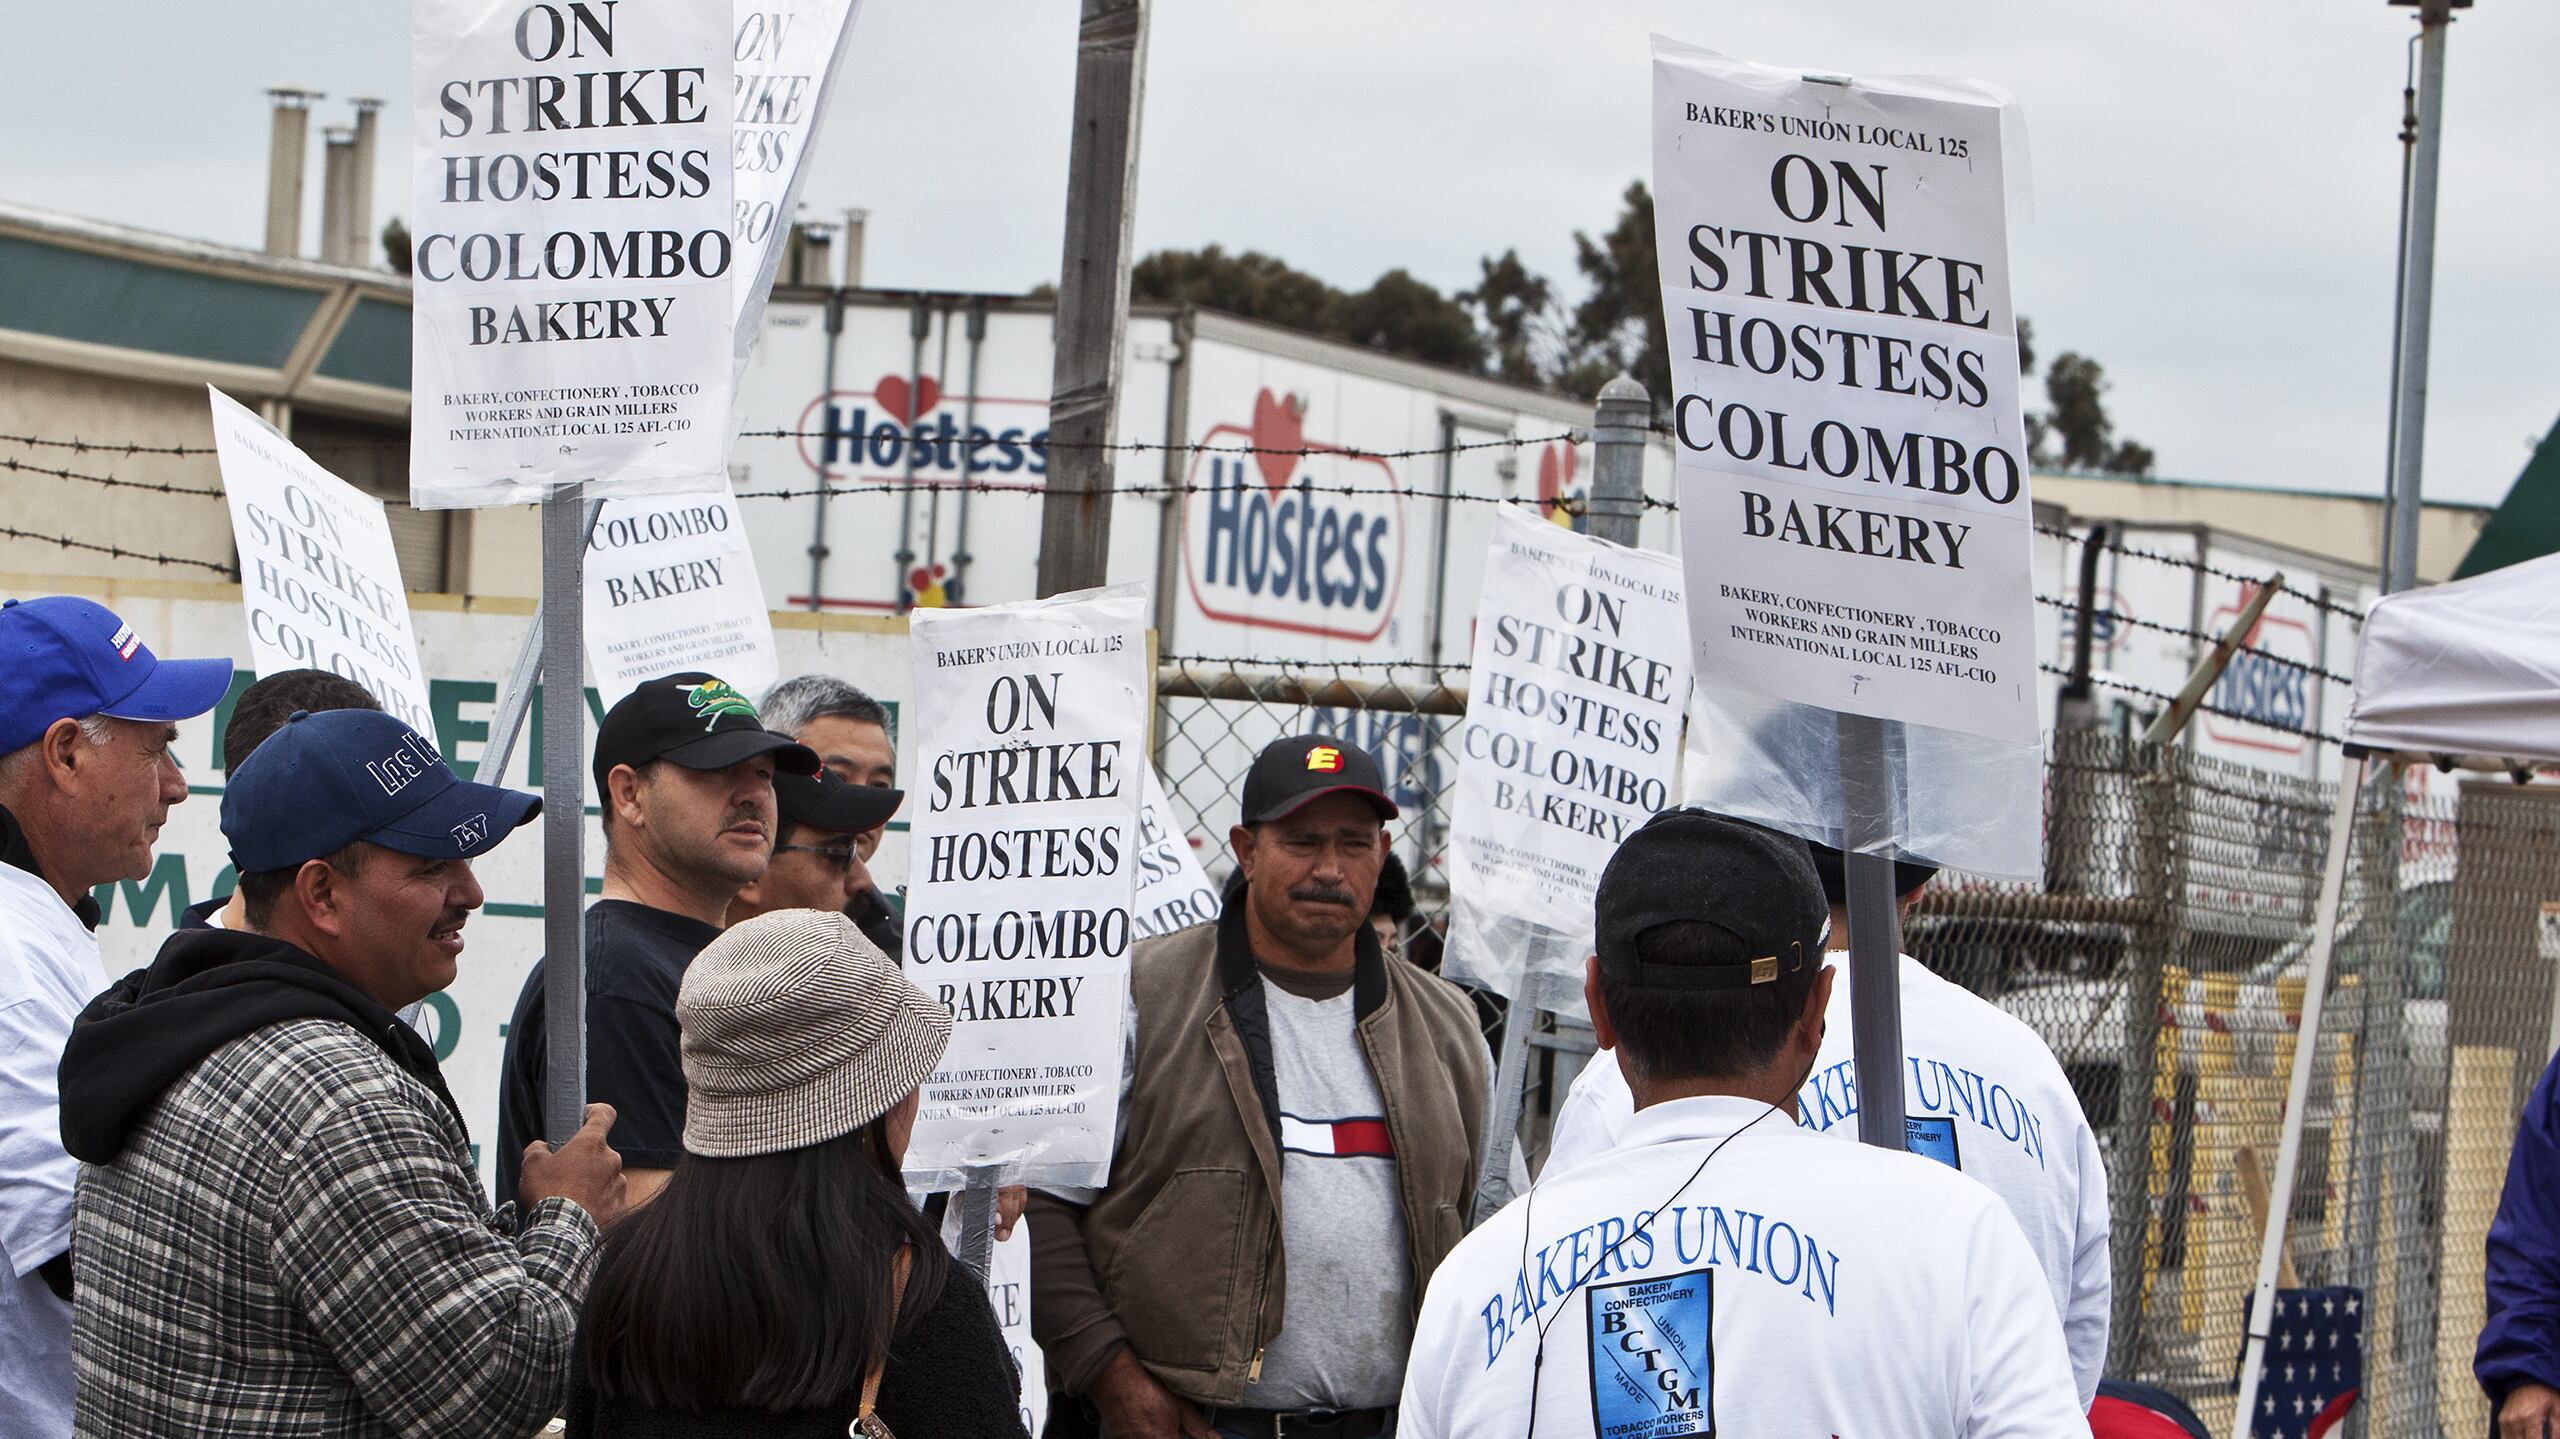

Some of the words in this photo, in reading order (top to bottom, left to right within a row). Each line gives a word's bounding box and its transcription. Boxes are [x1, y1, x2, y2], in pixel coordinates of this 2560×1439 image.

[515, 1, 618, 62] ON
[734, 12, 795, 63] ON
[440, 67, 708, 139] STRIKE
[1686, 102, 1775, 134] BAKER'S
[1780, 115, 1850, 143] UNION
[1858, 124, 1933, 153] LOCAL
[1938, 136, 1968, 159] 125
[440, 150, 711, 203] HOSTESS
[1771, 154, 1888, 233] ON
[417, 229, 732, 283] COLOMBO
[1688, 224, 1990, 330] STRIKE
[469, 297, 676, 346] BAKERY
[1686, 307, 1989, 408] HOSTESS
[465, 408, 533, 423] WORKERS
[536, 406, 563, 419] AND
[566, 404, 611, 418] GRAIN
[614, 402, 678, 416] MILLERS
[504, 386, 620, 403] CONFECTIONERY
[630, 383, 699, 398] TOBACCO
[450, 424, 560, 441] INTERNATIONAL
[562, 422, 610, 437] LOCAL
[613, 421, 635, 434] 125
[637, 419, 691, 433] AFL-CIO
[825, 407, 1050, 474] Hostess
[1675, 394, 2020, 505] COLOMBO
[284, 484, 344, 551] ON
[590, 504, 728, 551] COLOMBO
[1205, 456, 1388, 612] Hostess
[1740, 490, 1971, 569] BAKERY
[246, 502, 401, 631] STRIKE
[605, 557, 726, 608] BAKERY
[1614, 573, 1657, 598] LOCAL
[1661, 589, 1681, 604] 125
[256, 556, 412, 681] HOSTESS
[1556, 583, 1626, 638] ON
[1745, 608, 1818, 634] WORKERS
[1821, 624, 1851, 640] AND
[1855, 631, 1906, 648] GRAIN
[1910, 638, 1978, 660] MILLERS
[1786, 597, 1915, 629] CONFECTIONERY
[1926, 618, 2001, 644] TOBACCO
[999, 641, 1041, 662] UNION
[1046, 637, 1099, 657] LOCAL
[1104, 635, 1123, 653] 125
[1493, 615, 1672, 705] STRIKE
[1731, 625, 1849, 660] INTERNATIONAL
[1852, 648, 1906, 668] LOCAL
[1910, 657, 1932, 671] 125
[1935, 661, 1996, 684] AFL-CIO
[986, 672, 1063, 735] ON
[1484, 671, 1662, 755] HOSTESS
[930, 740, 1121, 813] STRIKE
[1307, 748, 1340, 770] E
[1464, 724, 1666, 814] COLOMBO
[450, 813, 488, 852] LV
[1493, 779, 1631, 844] BAKERY
[927, 825, 1121, 883] HOSTESS
[909, 907, 1130, 965] COLOMBO
[929, 1088, 972, 1102] WORKERS
[974, 1087, 995, 1100] AND
[996, 1085, 1030, 1098] GRAIN
[1032, 1084, 1076, 1097] MILLERS
[955, 1067, 1036, 1081] CONFECTIONERY
[1044, 1065, 1093, 1079] TOBACCO
[1907, 1056, 2045, 1172] UNION
[1481, 1210, 1656, 1371] BAKERS
[1672, 1206, 1840, 1318] UNION
[1605, 1288, 1695, 1311] CONFECTIONERY
[1628, 1281, 1673, 1297] BAKERY
[1657, 1315, 1687, 1352] UNION
[1614, 1371, 1645, 1405] MADE
[1605, 1417, 1656, 1437] TOBACCO
[1656, 1410, 1704, 1425] WORKERS
[1654, 1422, 1696, 1437] MILLERS
